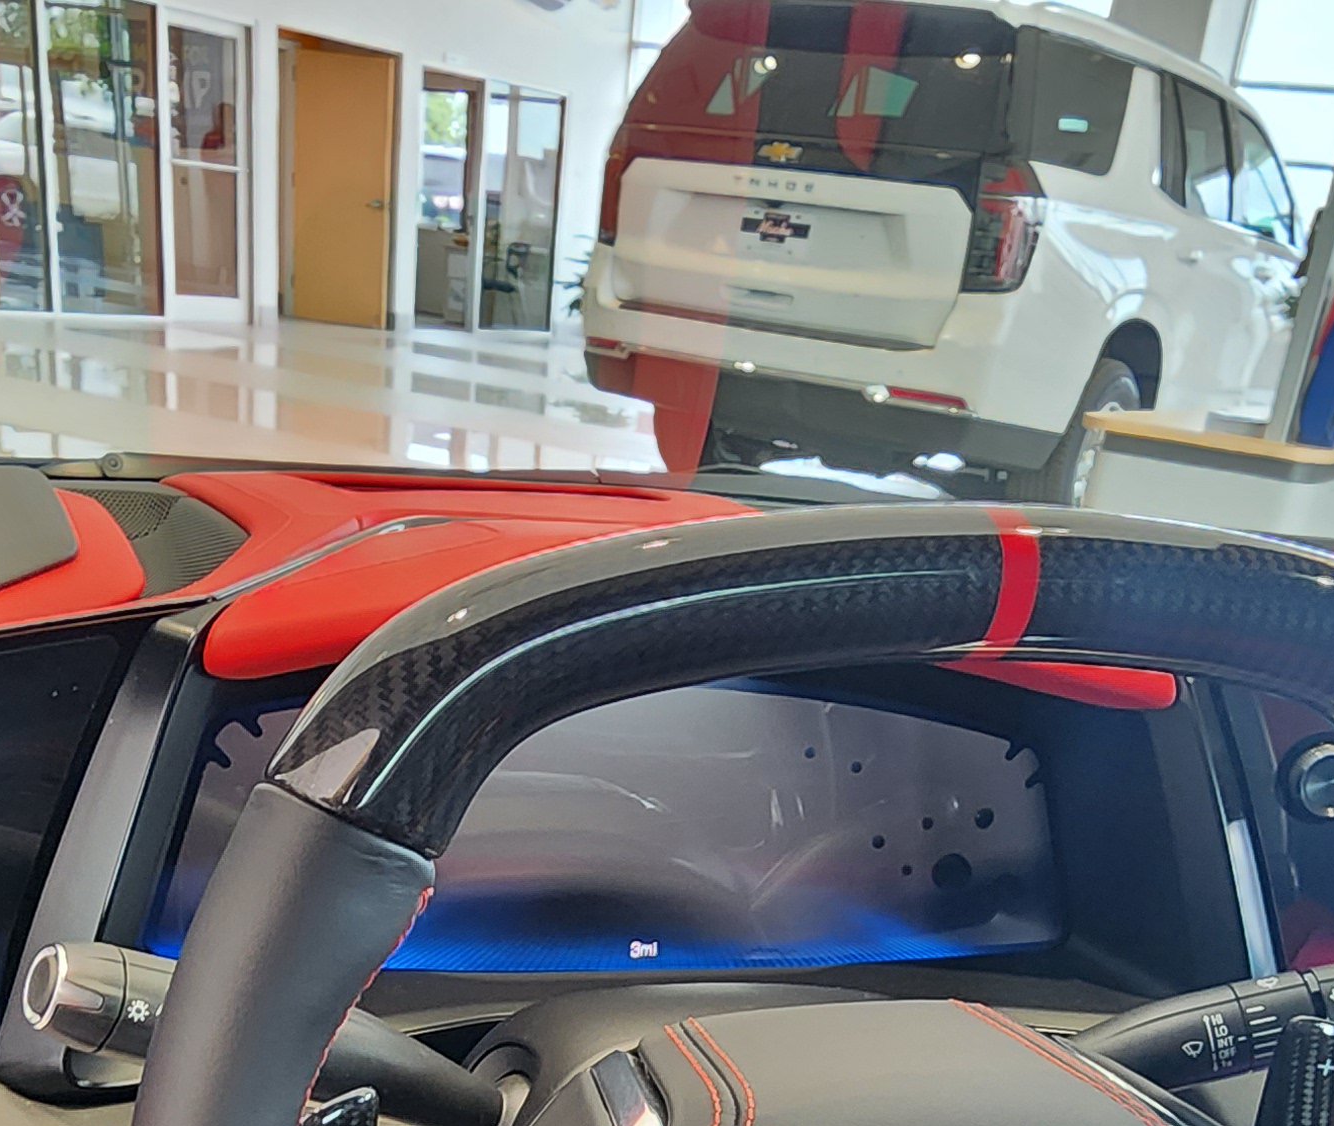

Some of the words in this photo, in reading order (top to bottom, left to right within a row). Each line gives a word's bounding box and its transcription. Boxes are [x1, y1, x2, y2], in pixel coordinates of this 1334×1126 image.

[1210, 1013, 1224, 1026] HI
[1214, 1025, 1228, 1038] LO
[1217, 1035, 1234, 1049] INT
[1218, 1046, 1237, 1060] OFF
